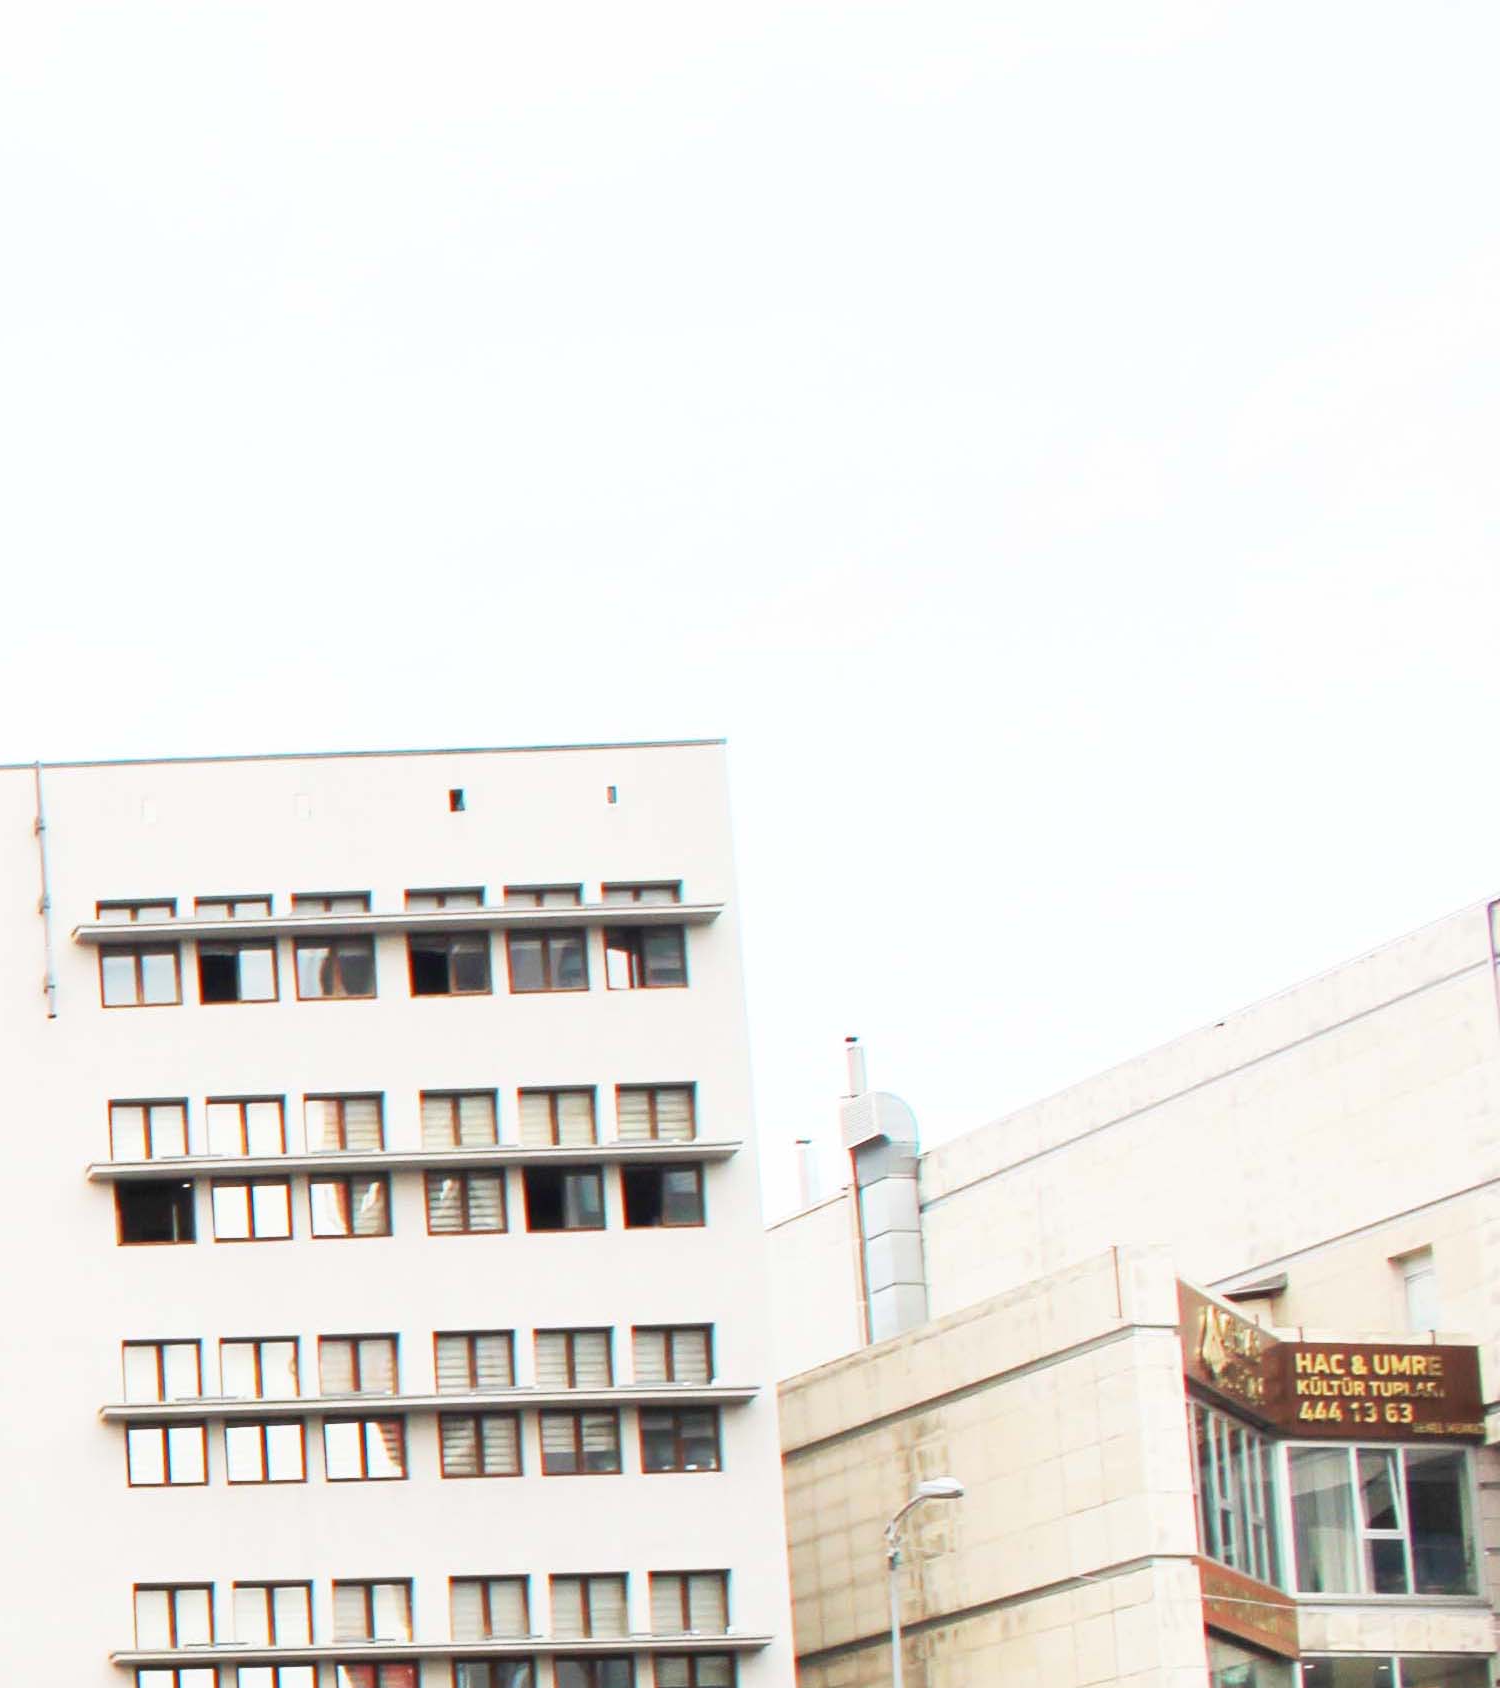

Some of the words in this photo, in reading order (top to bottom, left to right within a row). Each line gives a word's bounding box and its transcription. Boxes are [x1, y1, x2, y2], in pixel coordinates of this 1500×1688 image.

[1295, 1353, 1345, 1375] HAC
[1350, 1354, 1368, 1375] &
[1373, 1354, 1444, 1376] UMRE
[1296, 1377, 1365, 1397] KÜLTÜR
[1300, 1402, 1342, 1422] 444
[1384, 1403, 1414, 1423] 63
